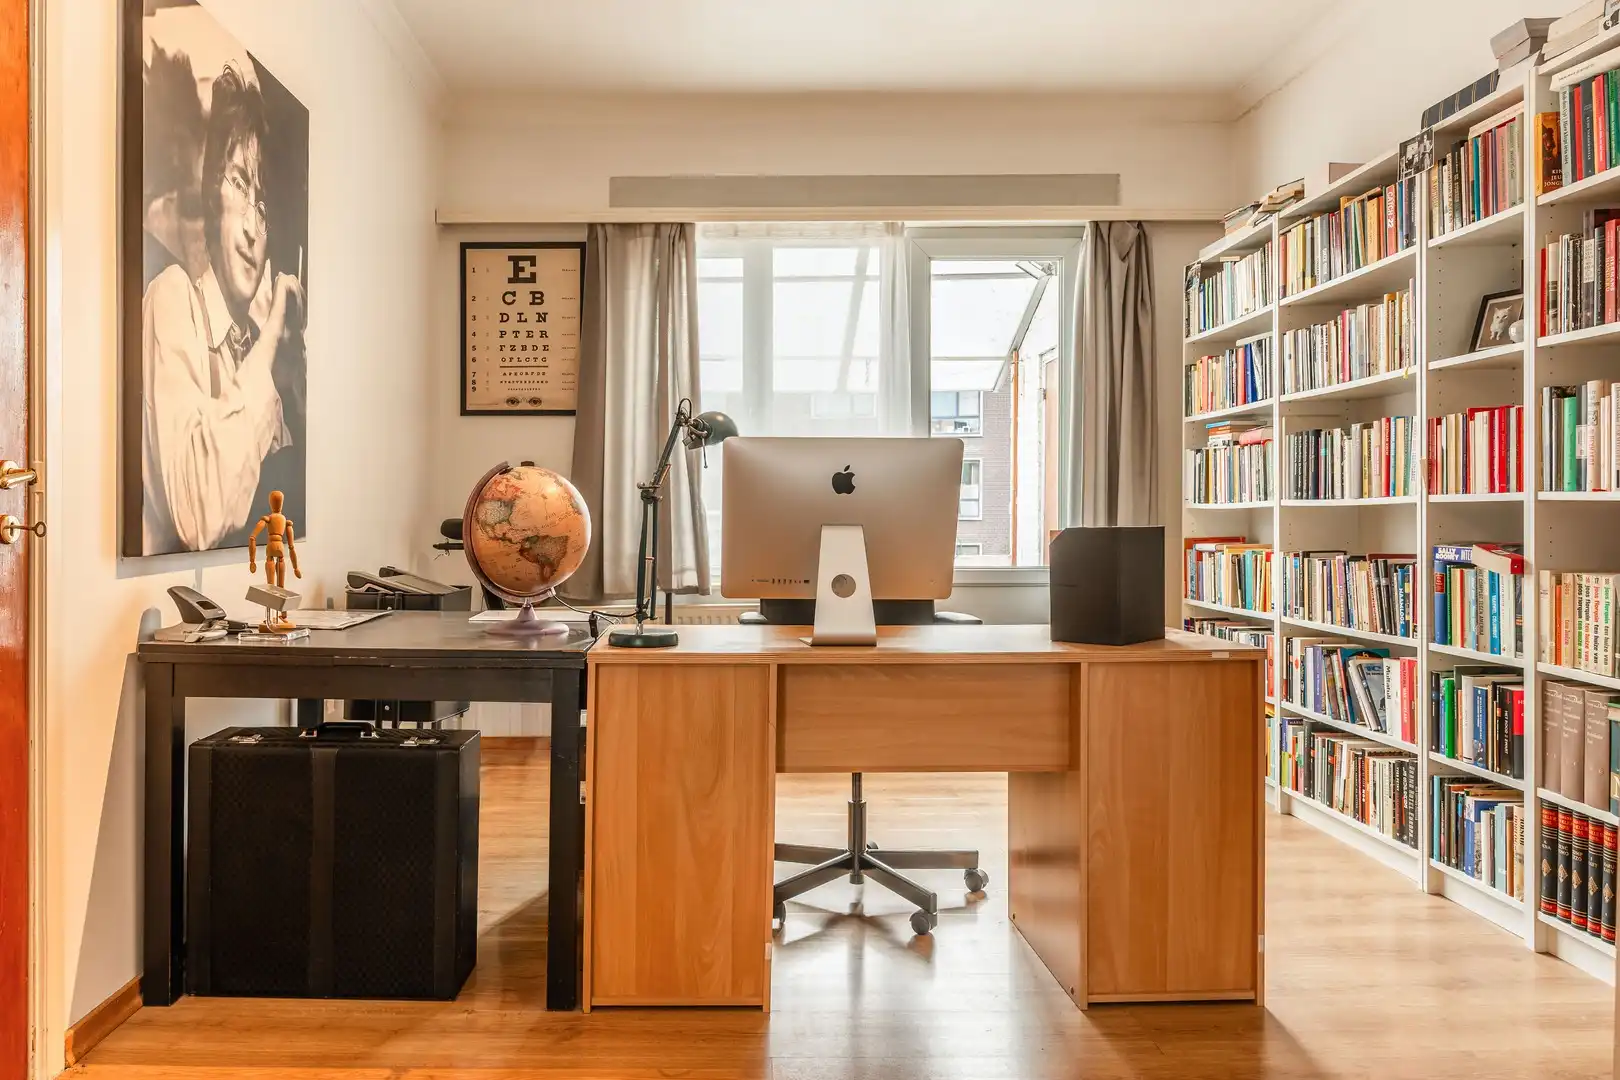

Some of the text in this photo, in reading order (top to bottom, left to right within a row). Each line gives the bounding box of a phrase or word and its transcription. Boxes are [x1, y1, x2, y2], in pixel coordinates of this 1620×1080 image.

[508, 255, 536, 284] E
[502, 290, 544, 306] C B
